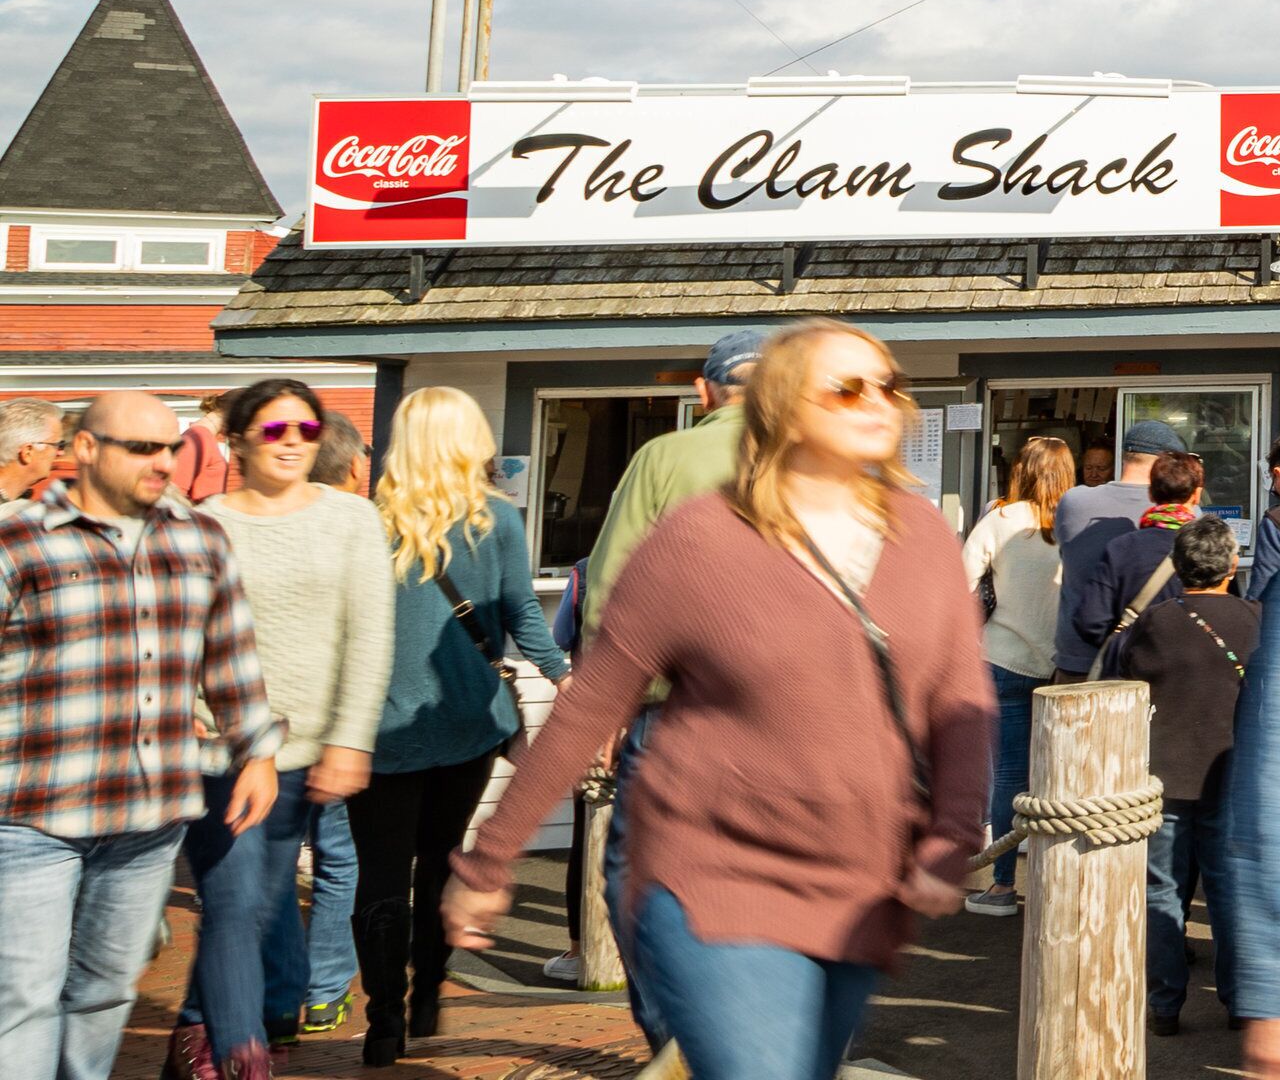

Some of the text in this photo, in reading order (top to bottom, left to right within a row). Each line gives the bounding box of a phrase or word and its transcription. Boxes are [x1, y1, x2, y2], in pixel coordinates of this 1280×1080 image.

[322, 134, 468, 178] Coca-Cola
[511, 127, 1178, 210] The Clam Shack
[373, 178, 410, 189] classic
